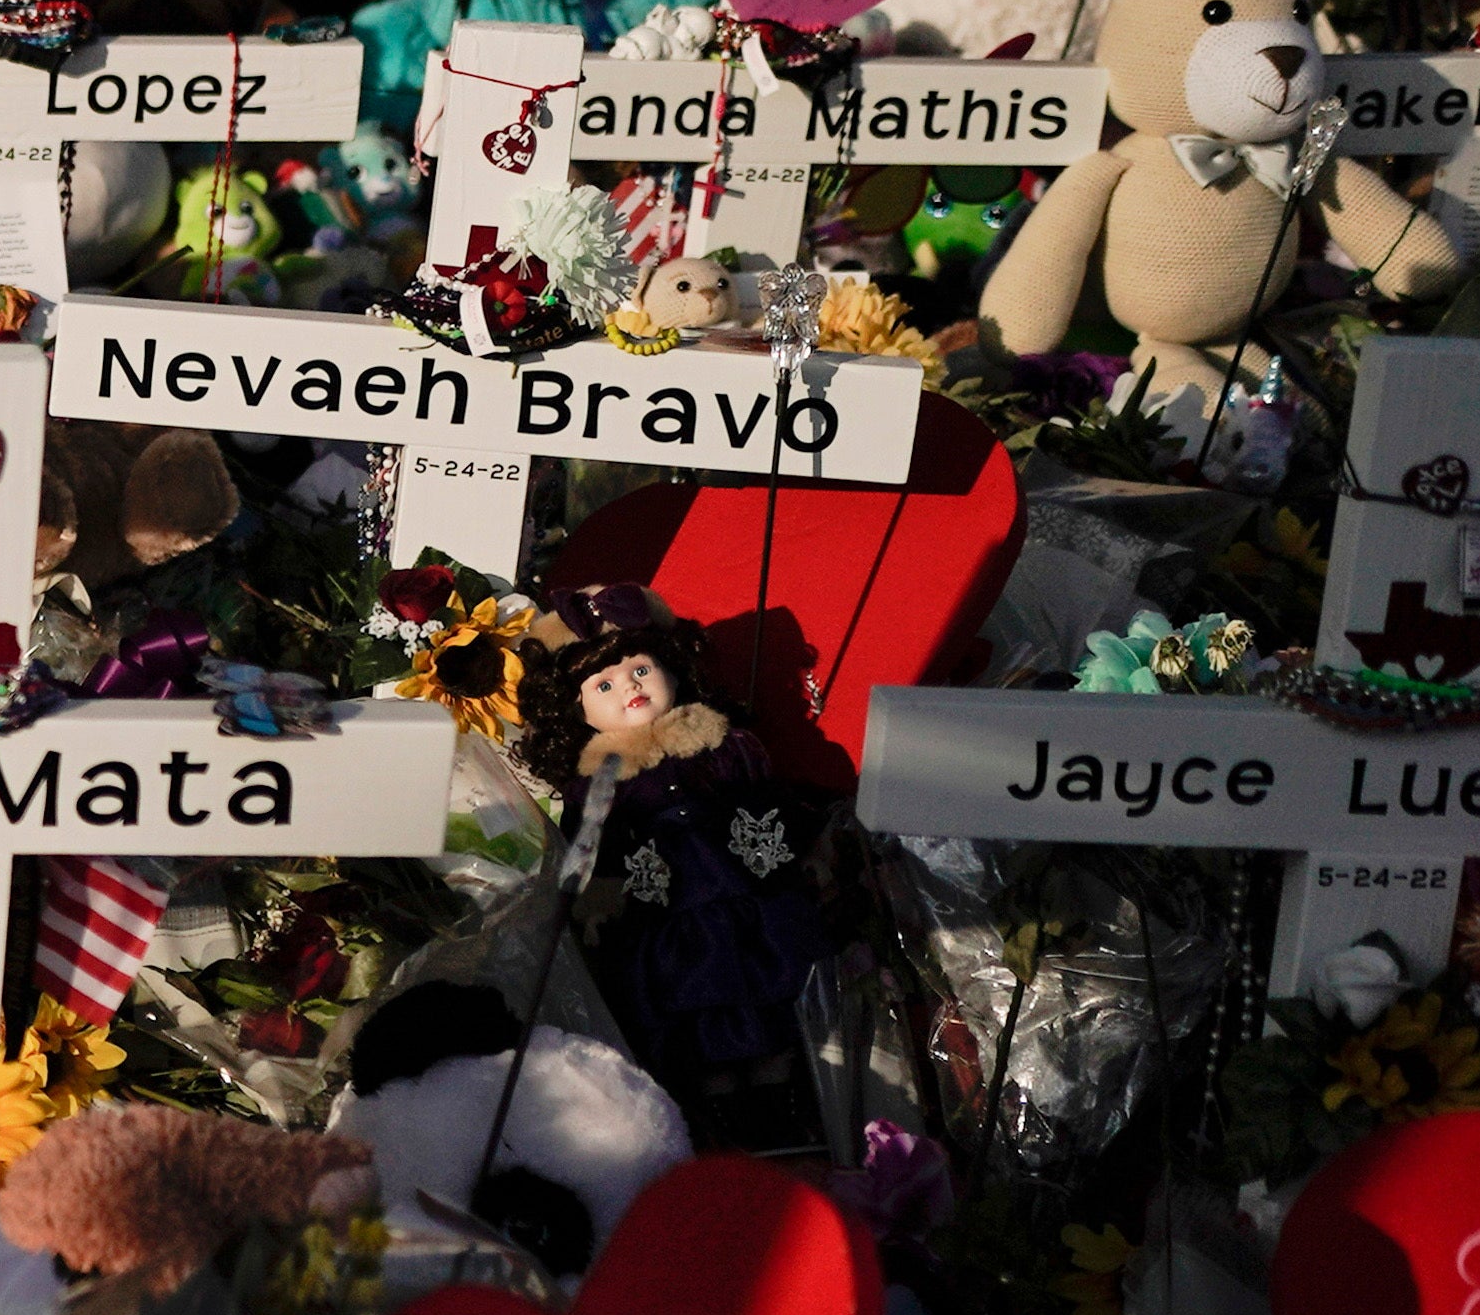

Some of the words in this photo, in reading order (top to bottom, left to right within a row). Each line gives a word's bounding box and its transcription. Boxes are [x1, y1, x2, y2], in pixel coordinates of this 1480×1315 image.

[48, 72, 269, 121] Lopez
[580, 86, 756, 137] anda
[804, 86, 1068, 140] Mathis
[721, 166, 807, 185] 5-24-22
[99, 337, 470, 424] Nevaeh
[516, 367, 839, 452] Bravo
[415, 458, 520, 480] 5-24-22
[1007, 741, 1275, 816] Jayce
[1319, 867, 1446, 889] 5-24-22
